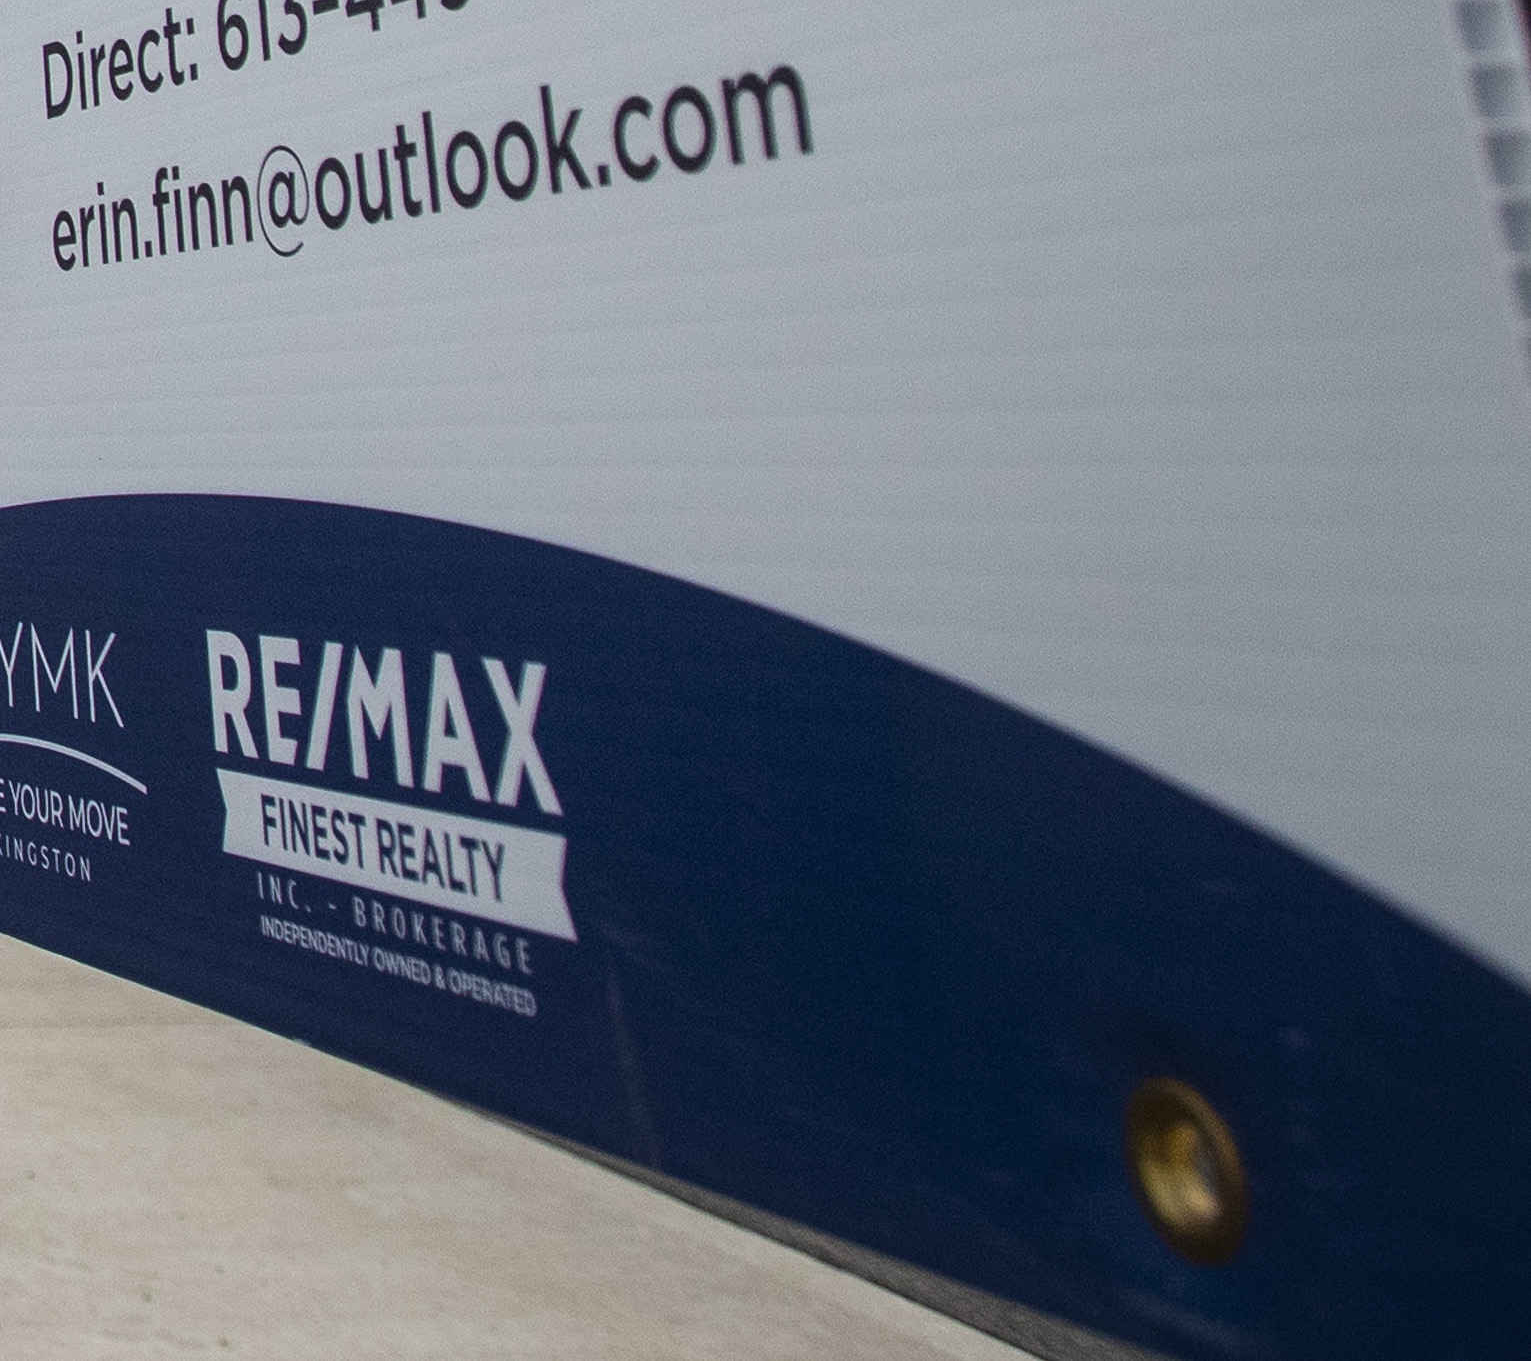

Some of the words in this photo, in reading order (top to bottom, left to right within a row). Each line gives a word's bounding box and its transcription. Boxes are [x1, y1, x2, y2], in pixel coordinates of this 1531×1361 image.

[42, 8, 200, 119] Direct:
[52, 64, 815, 272] erin.finn@outlook.com
[206, 629, 564, 817] RE/MAX
[9, 780, 64, 828] YOUR
[69, 795, 130, 846] MOVE
[260, 794, 366, 865] FINEST
[378, 824, 506, 903] REALTY
[257, 871, 311, 912] INC.
[352, 896, 533, 975] BROKERAGE
[260, 914, 370, 967] INDEPENDENTLY
[371, 946, 432, 985] OWNED
[433, 963, 447, 990] &
[446, 966, 538, 1018] OPERATED
